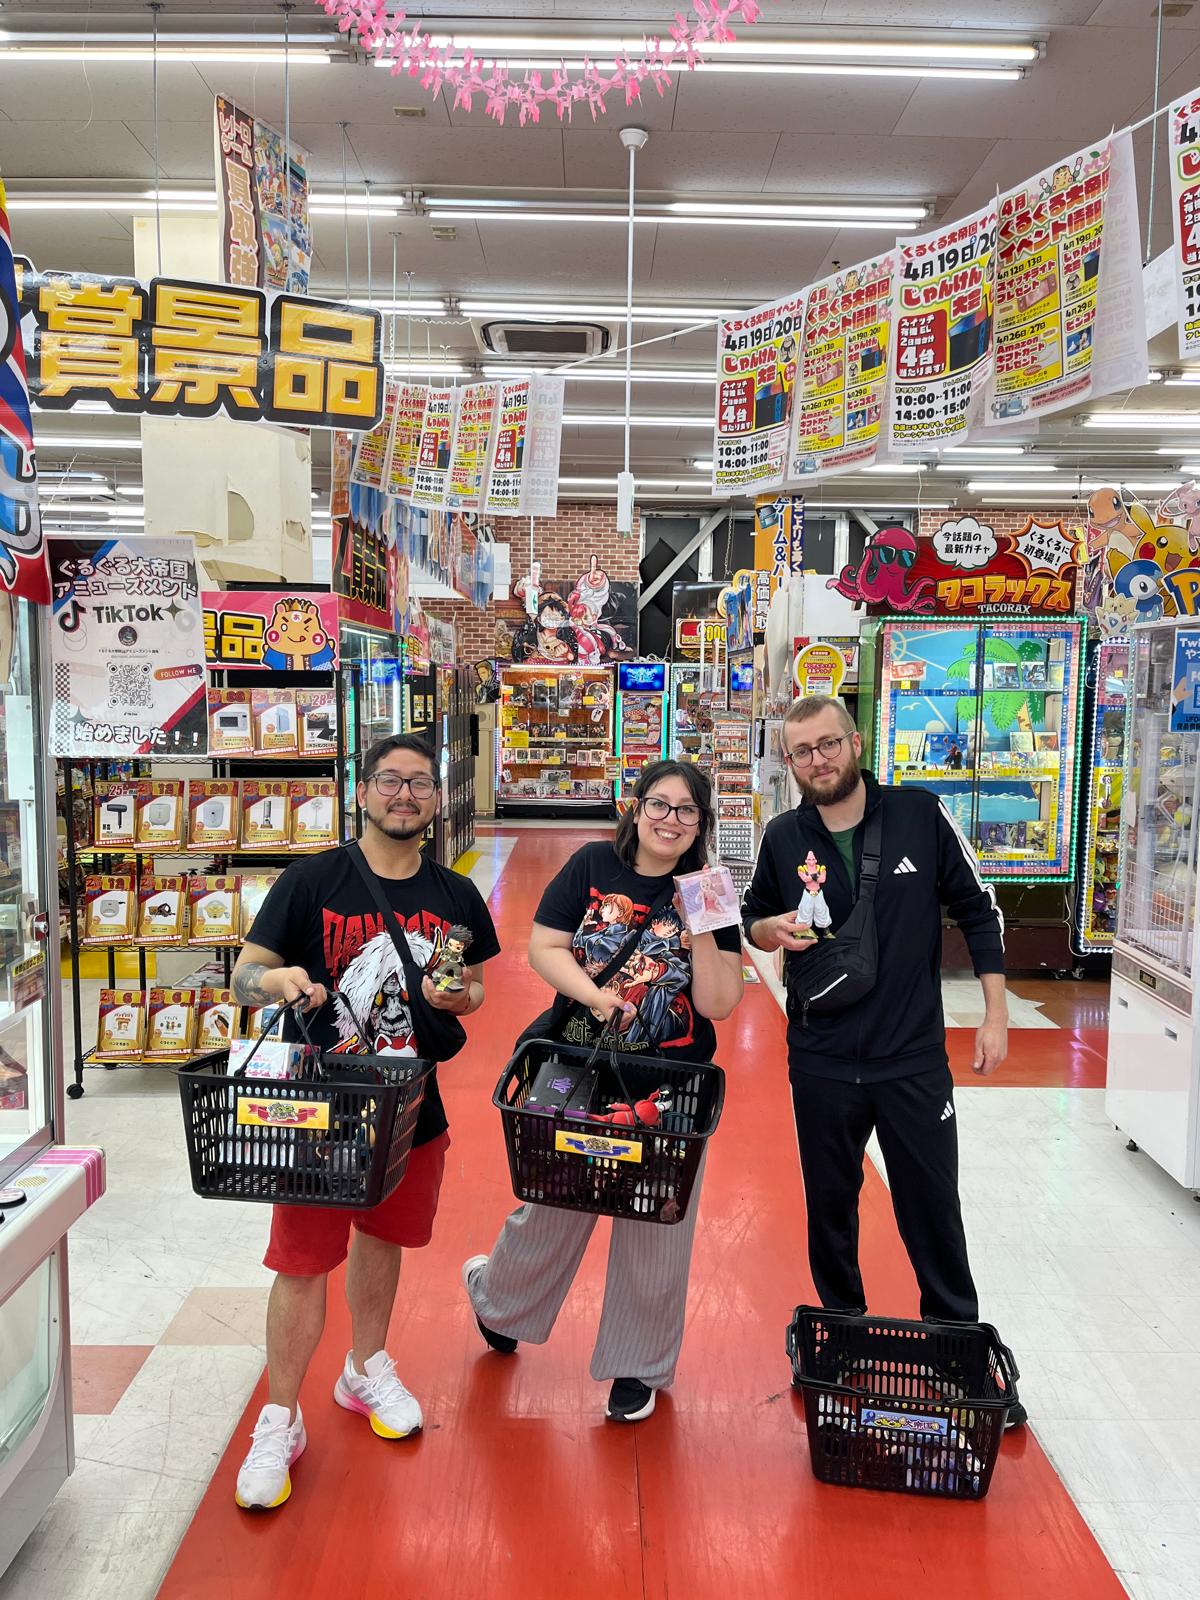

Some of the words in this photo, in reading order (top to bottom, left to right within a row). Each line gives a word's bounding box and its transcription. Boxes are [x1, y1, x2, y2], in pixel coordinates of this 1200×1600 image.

[904, 267, 982, 306] じゃんけん
[952, 288, 982, 317] 大会
[901, 314, 935, 327] スイッチ
[15, 264, 379, 420] 賞景品
[997, 336, 1039, 354] Amazon
[725, 347, 777, 372] じゃんけん
[900, 346, 935, 367] 4台
[722, 406, 748, 423] 4台
[942, 531, 982, 542] 今話題の
[1029, 530, 1070, 555] ぐるぐるに
[944, 543, 991, 554] 最新ガチャ
[58, 556, 189, 580] ぐるぐる大帝国
[937, 575, 1073, 613] タコラックス
[93, 604, 164, 624] TikTok
[977, 603, 1032, 615] TACORAX
[160, 669, 185, 678] FOLLOW
[187, 667, 197, 675] ME
